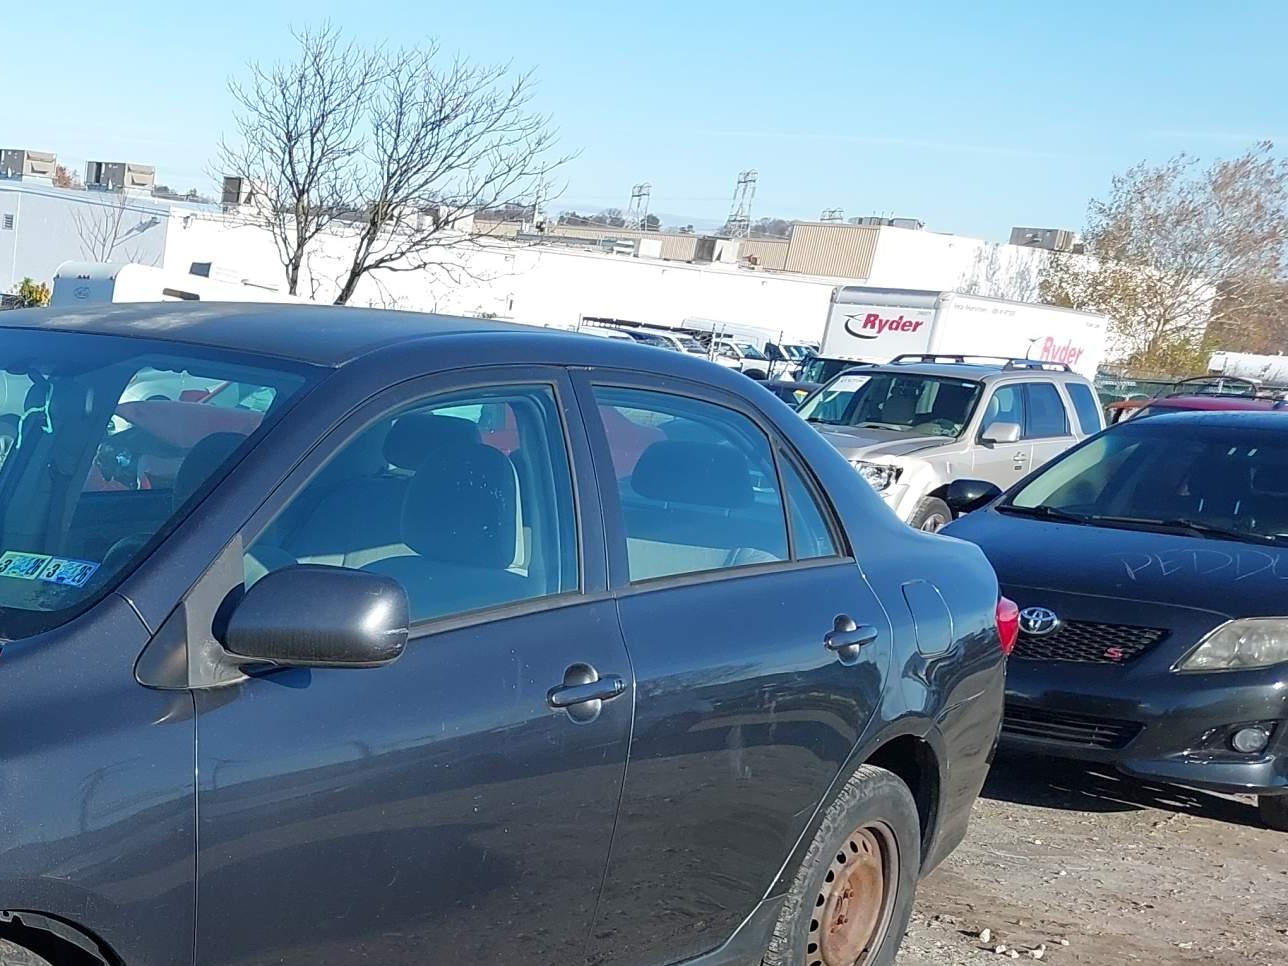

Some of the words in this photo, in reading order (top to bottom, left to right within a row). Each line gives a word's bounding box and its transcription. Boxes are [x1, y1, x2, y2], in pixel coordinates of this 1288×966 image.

[862, 313, 924, 334] Ryder
[1040, 336, 1083, 365] Ryder
[45, 563, 61, 578] 3
